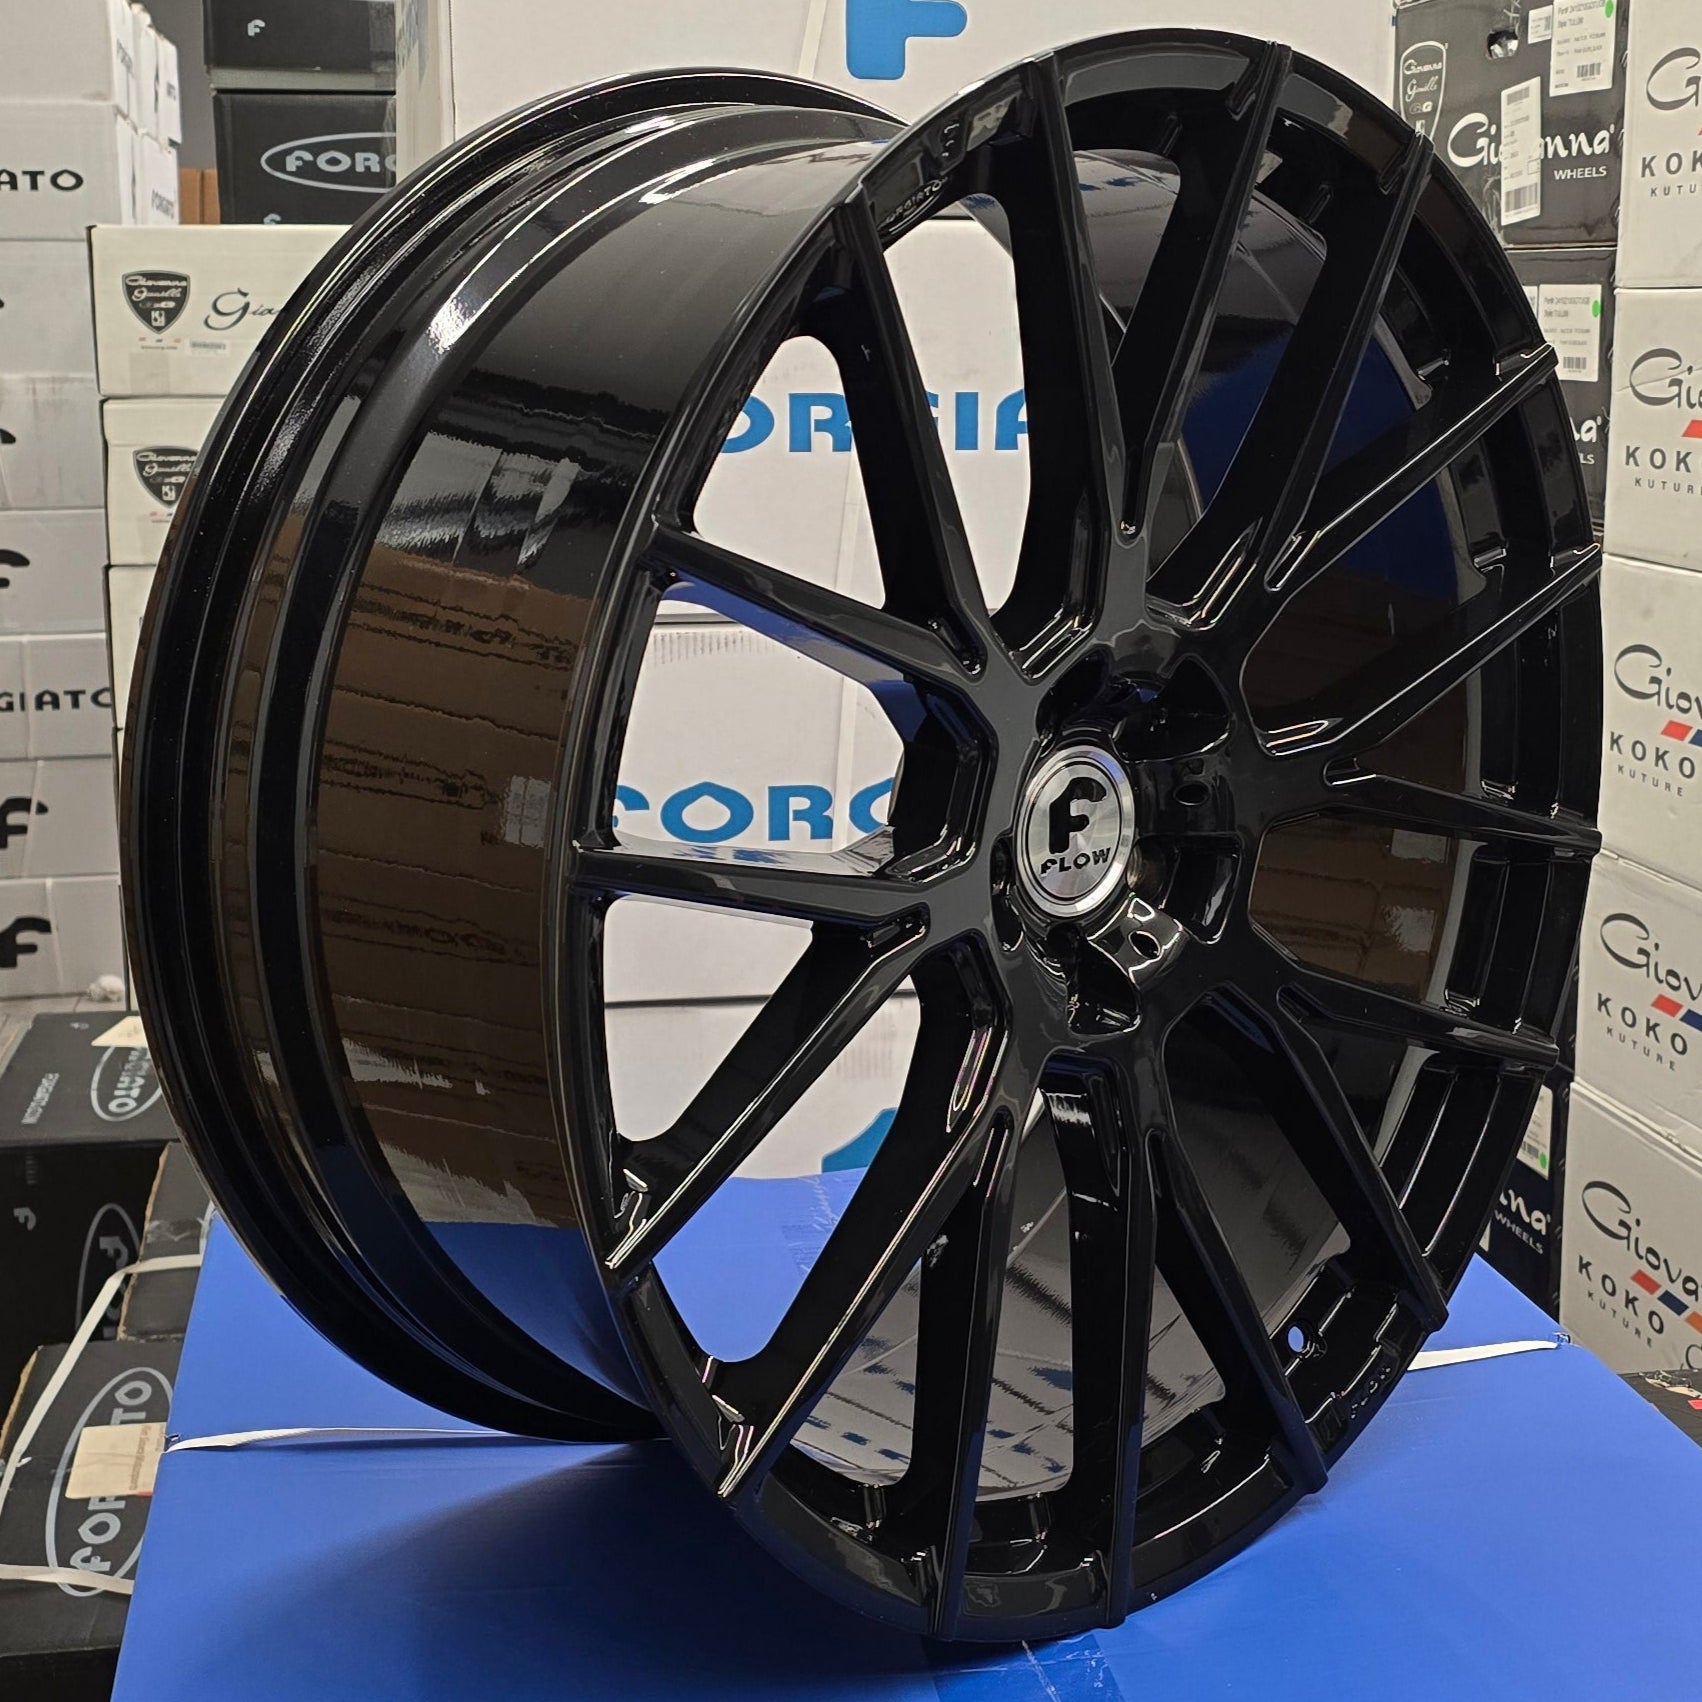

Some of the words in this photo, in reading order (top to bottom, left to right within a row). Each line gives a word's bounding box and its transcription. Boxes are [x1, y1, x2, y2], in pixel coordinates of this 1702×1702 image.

[247, 19, 266, 36] F
[1448, 113, 1610, 167] Ginna
[1553, 166, 1607, 180] WHEELS
[1629, 347, 1702, 410] Gi
[1634, 477, 1702, 496] KUTUR
[1609, 731, 1695, 779] KOKO
[1617, 764, 1684, 797] KUTURE
[1049, 777, 1107, 854] F
[1041, 847, 1111, 875] FLOW
[1597, 993, 1688, 1056] KOKO
[1606, 1026, 1676, 1071] KUTURE
[1494, 1209, 1544, 1254] WHEELS
[1579, 1254, 1664, 1335] KOKO
